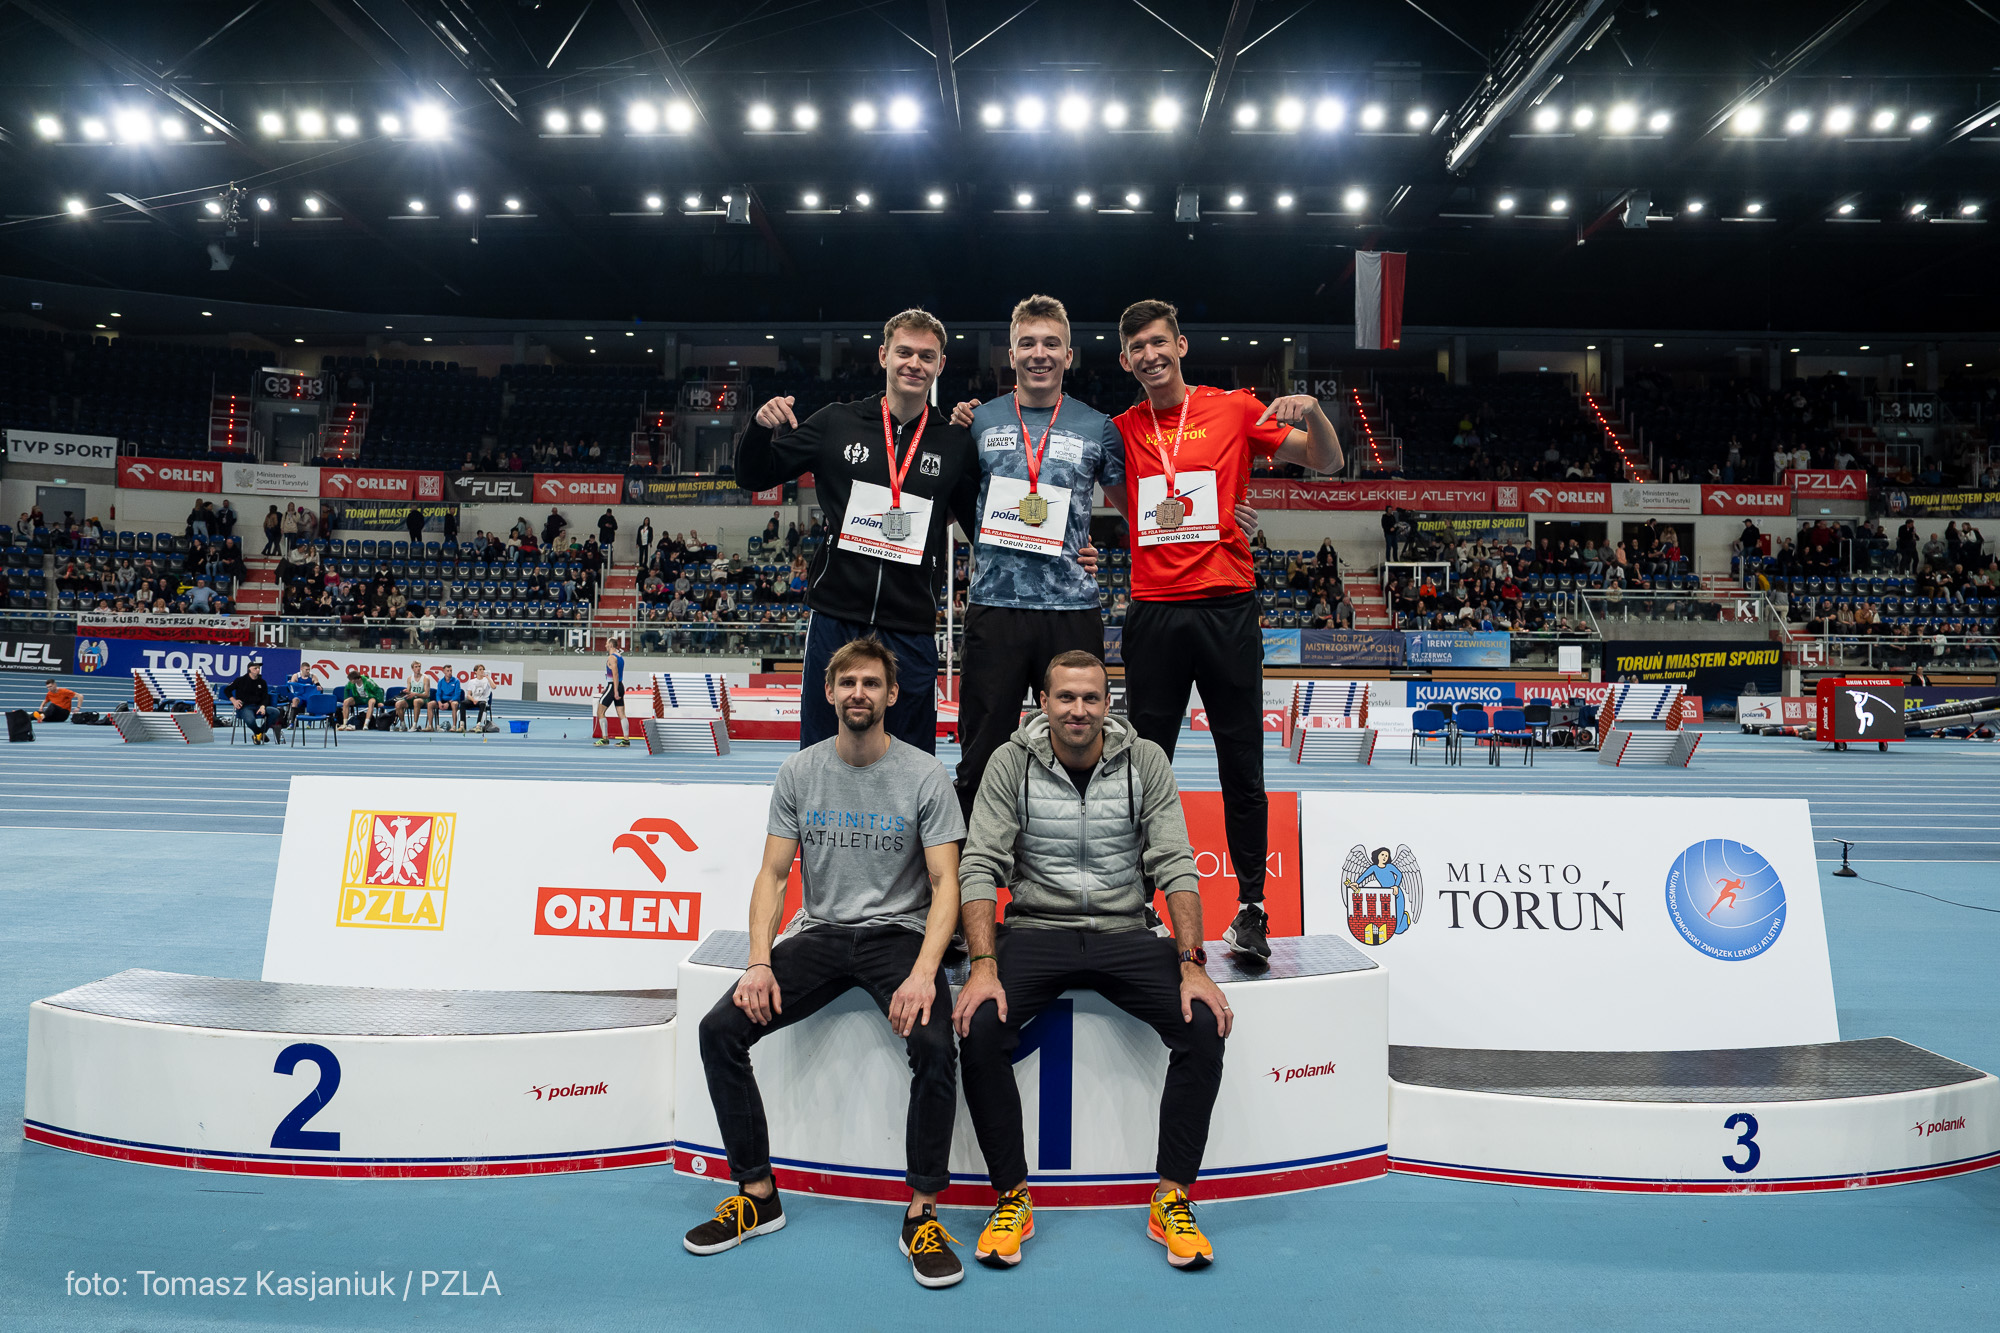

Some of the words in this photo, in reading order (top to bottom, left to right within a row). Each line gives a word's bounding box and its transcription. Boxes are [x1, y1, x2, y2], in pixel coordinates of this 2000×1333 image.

[264, 376, 291, 394] G3
[299, 379, 324, 396] H3
[1288, 379, 1308, 395] J3
[1314, 379, 1337, 396] K3
[690, 391, 711, 406] H3
[1880, 402, 1901, 418] L3
[1909, 402, 1933, 418] M3
[10, 439, 49, 454] TVP
[54, 442, 114, 458] SPORT
[904, 457, 913, 467] 2024
[159, 467, 214, 483] ORLEN
[256, 471, 297, 479] Ministerstwo
[256, 478, 277, 486] Sportu
[281, 479, 309, 487] Turystyki
[455, 477, 475, 487] 4F
[1795, 474, 1857, 489] PZLA
[356, 477, 407, 490] ORLEN
[472, 481, 524, 497] FUEL
[568, 482, 617, 494] ORLEN
[677, 480, 714, 491] MIASTEM
[1246, 488, 1285, 499] OLSKI
[1289, 489, 1356, 502] ZWIĄZEK
[1360, 491, 1417, 501] LEKKIEJ
[1421, 491, 1486, 502] ATLETYKI
[1557, 491, 1605, 503] ORLEN
[1735, 494, 1783, 506] ORLEN
[1941, 493, 1982, 504] MIASTEM
[851, 515, 882, 529] polan
[991, 510, 1023, 522] polan
[1491, 518, 1526, 529] SPORTU
[1024, 543, 1042, 551] 2024
[884, 551, 902, 559] 2024
[1737, 600, 1760, 617] K1
[260, 625, 284, 642] H1
[568, 630, 591, 647] H1
[1332, 634, 1350, 643] 100.
[1353, 634, 1374, 643] PZLA
[1262, 637, 1297, 646] WIŃSKIEJ
[1305, 643, 1367, 652] MISTRZOSTWA
[1370, 644, 1400, 653] POLSKI
[1427, 640, 1452, 648] IRENY
[1454, 638, 1507, 649] SZEWIŃSKIEJ
[0, 642, 62, 665] UEL
[1803, 643, 1824, 661] L1
[143, 650, 263, 677] TORUŃ
[1617, 651, 1662, 671] TORUŃ
[1665, 653, 1727, 669] MIASTEM
[1729, 650, 1780, 667] SPORTU
[345, 664, 403, 680] ORLEN
[457, 670, 513, 685] OREN
[1643, 669, 1697, 679] www.torun.pl
[1416, 686, 1501, 700] KUJAWSKO
[1524, 687, 1608, 701] KUJAWSKO
[1263, 698, 1285, 706] ystyki
[782, 708, 801, 716] pola
[806, 810, 905, 832] INFINITUS
[804, 830, 904, 851] ATHLETICS
[1447, 862, 1582, 884] MIASTO
[343, 889, 439, 925] PZLA
[1438, 880, 1626, 931] TORUŃ
[543, 894, 691, 934] ORLEN
[1669, 870, 1702, 946] KUJAWSKO-POMORSKI
[1700, 942, 1733, 958] ZWIĄZEK
[1733, 943, 1762, 958] LEKKIEJ
[1760, 917, 1782, 947] ATLETYKI
[1284, 1061, 1336, 1083] polanik
[548, 1081, 608, 1101] polanik
[1012, 998, 1074, 1170] 1
[270, 1042, 342, 1151] 2
[1926, 1116, 1966, 1137] polanik
[1721, 1112, 1761, 1174] 3
